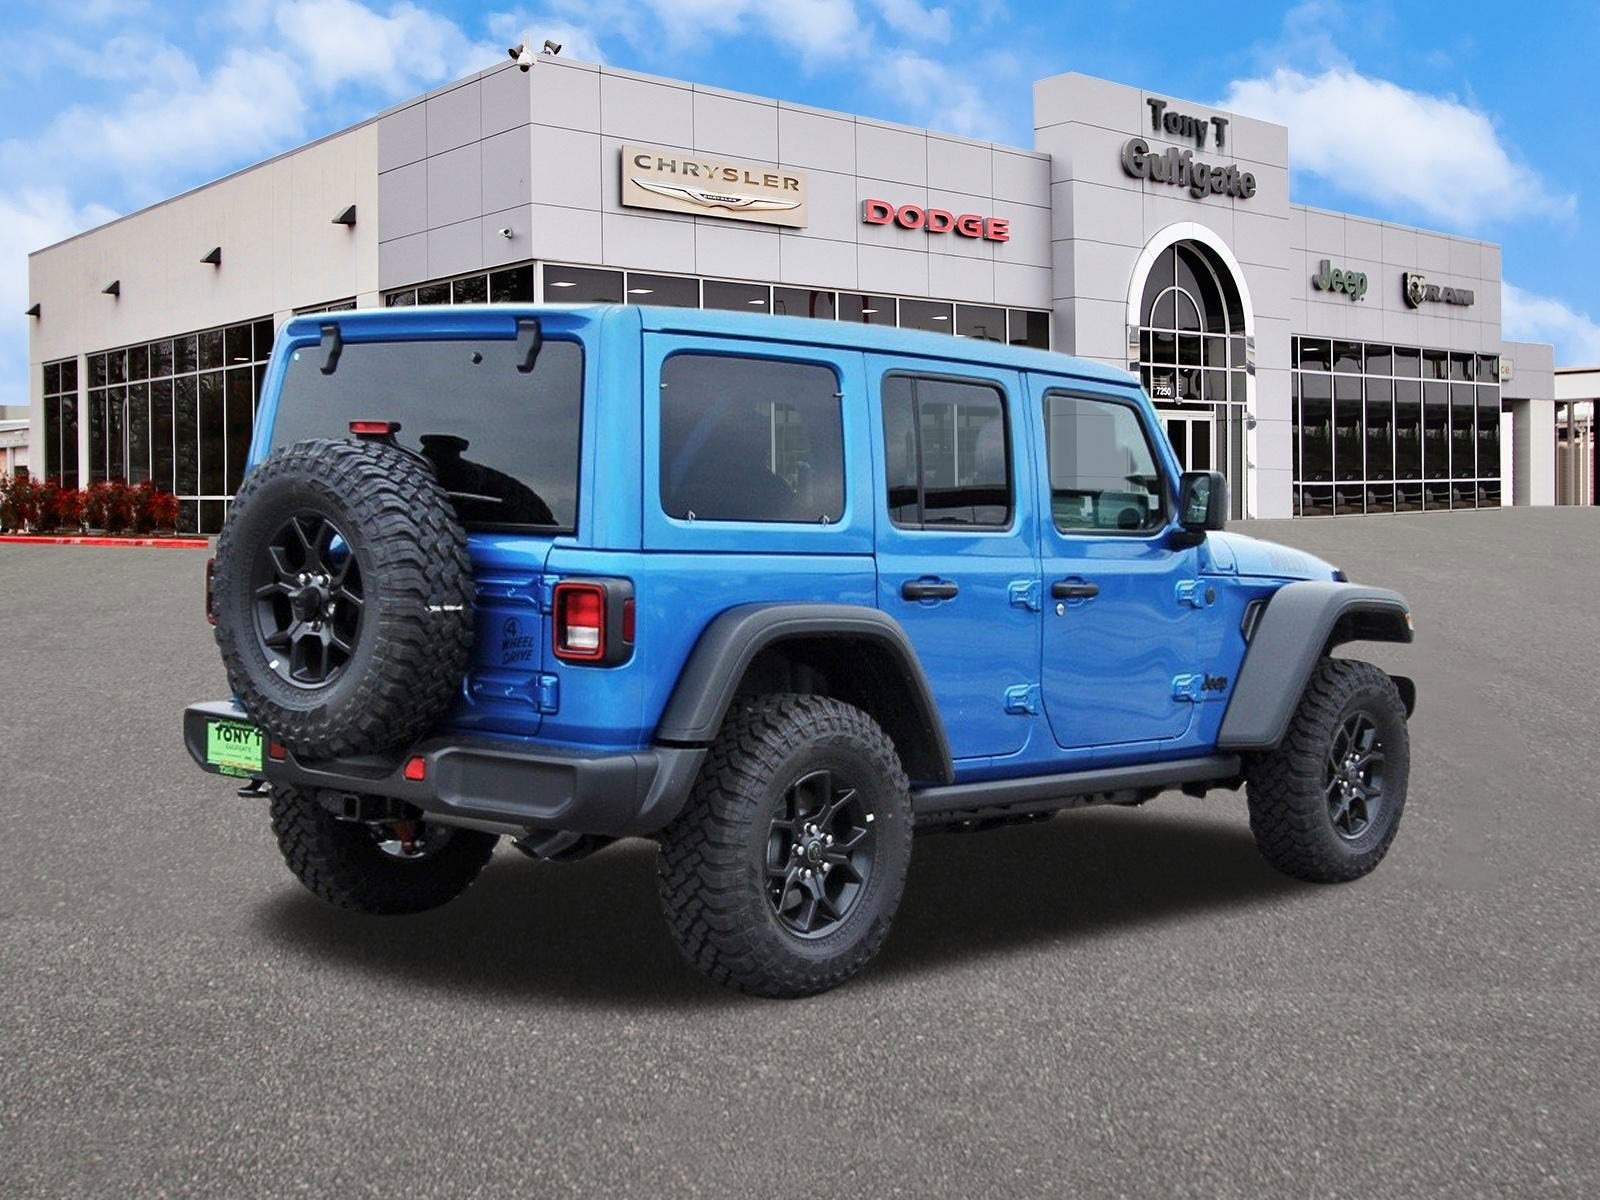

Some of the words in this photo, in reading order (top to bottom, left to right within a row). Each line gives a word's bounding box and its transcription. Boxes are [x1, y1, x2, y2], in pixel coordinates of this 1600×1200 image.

[1147, 98, 1208, 148] Tony
[1211, 117, 1229, 147] T
[634, 154, 800, 191] CHRYSLER
[1121, 138, 1256, 199] Gulfgate
[862, 199, 1010, 242] DODGE
[1313, 259, 1368, 302] Jeep
[1425, 284, 1475, 306] RAM
[1156, 387, 1172, 396] 7250
[502, 636, 534, 649] WHEEL
[502, 650, 533, 665] DRIVE
[1202, 673, 1228, 693] Jeep
[215, 725, 251, 745] TONY
[254, 731, 262, 746] T
